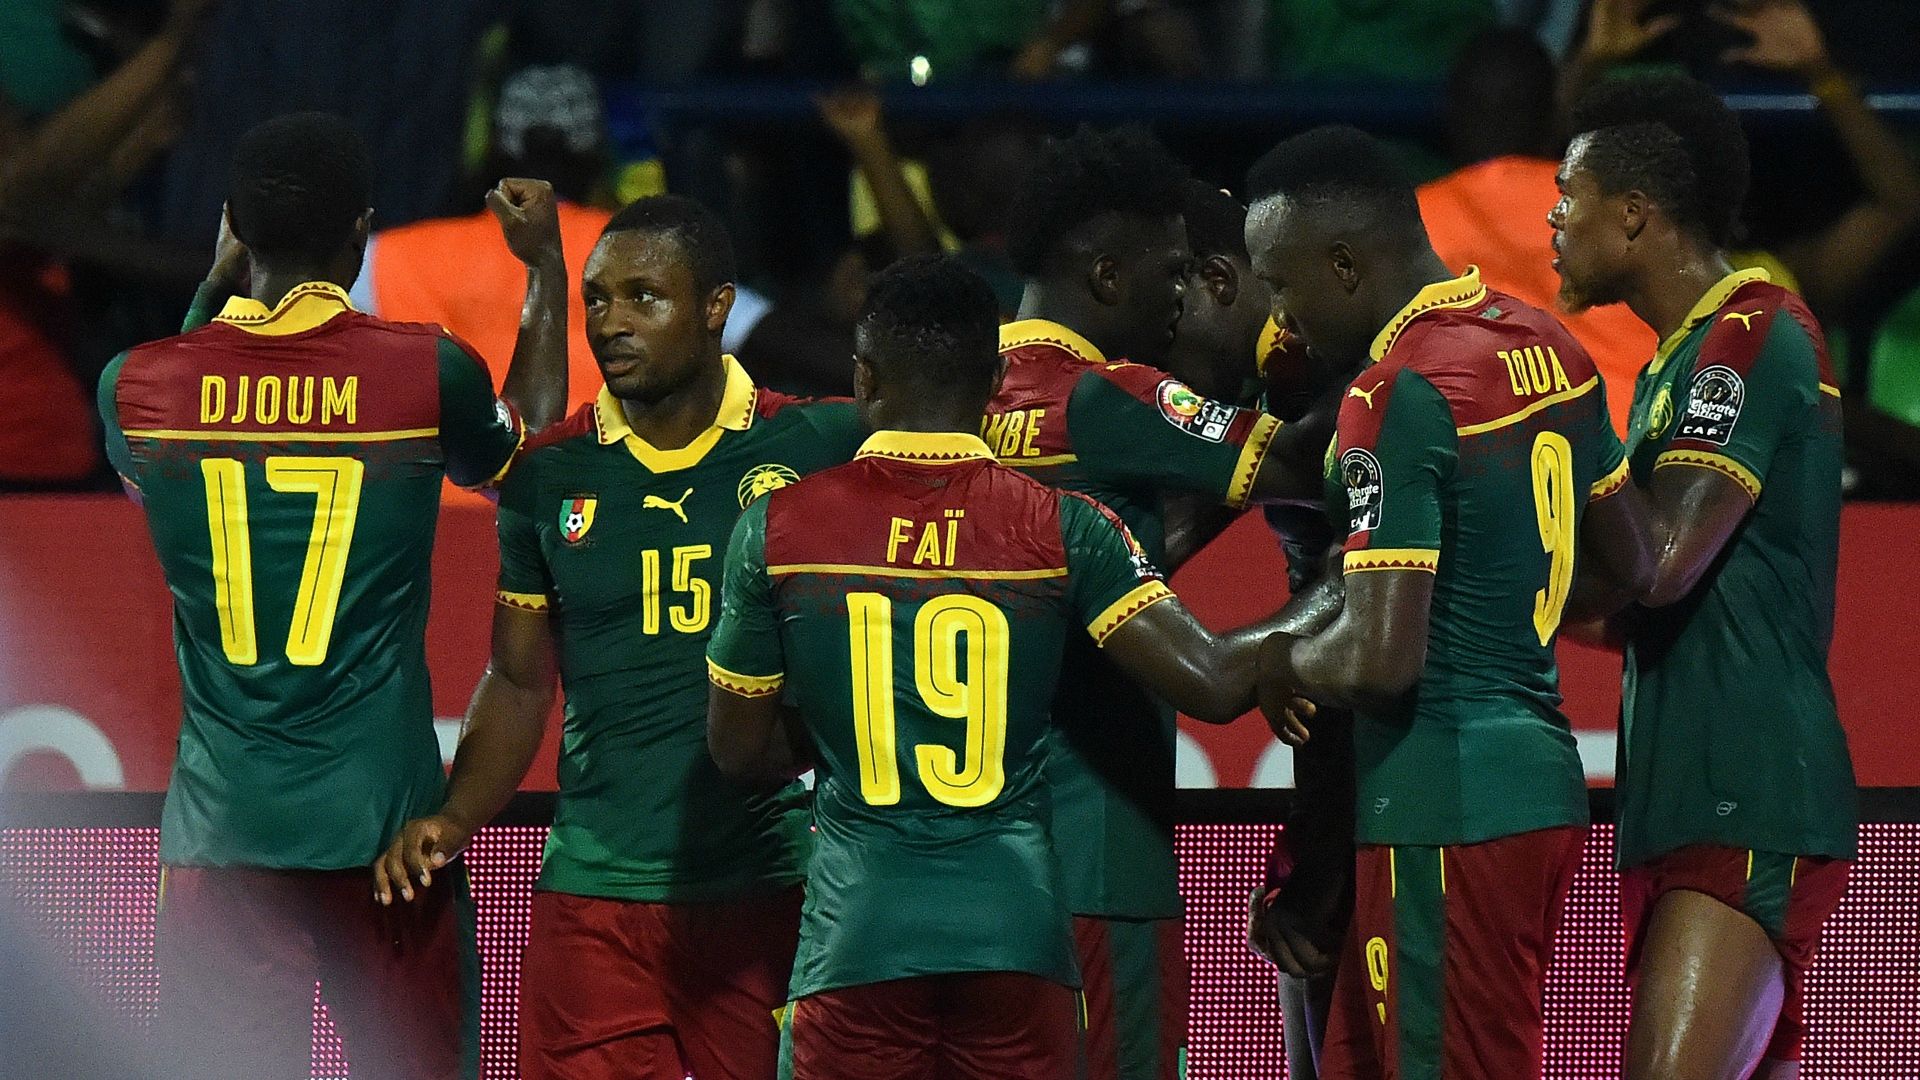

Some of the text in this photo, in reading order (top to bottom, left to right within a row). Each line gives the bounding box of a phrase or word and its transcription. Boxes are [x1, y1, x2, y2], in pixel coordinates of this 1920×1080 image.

[200, 375, 358, 425] DJOUM
[1497, 345, 1571, 397] ZOUA
[980, 409, 1045, 457] MBE
[201, 456, 364, 666] 17
[886, 509, 965, 567] FAÏ
[1531, 431, 1575, 647] 9
[641, 544, 711, 635] 15
[846, 591, 1010, 808] 19
[1366, 936, 1389, 1025] 9
